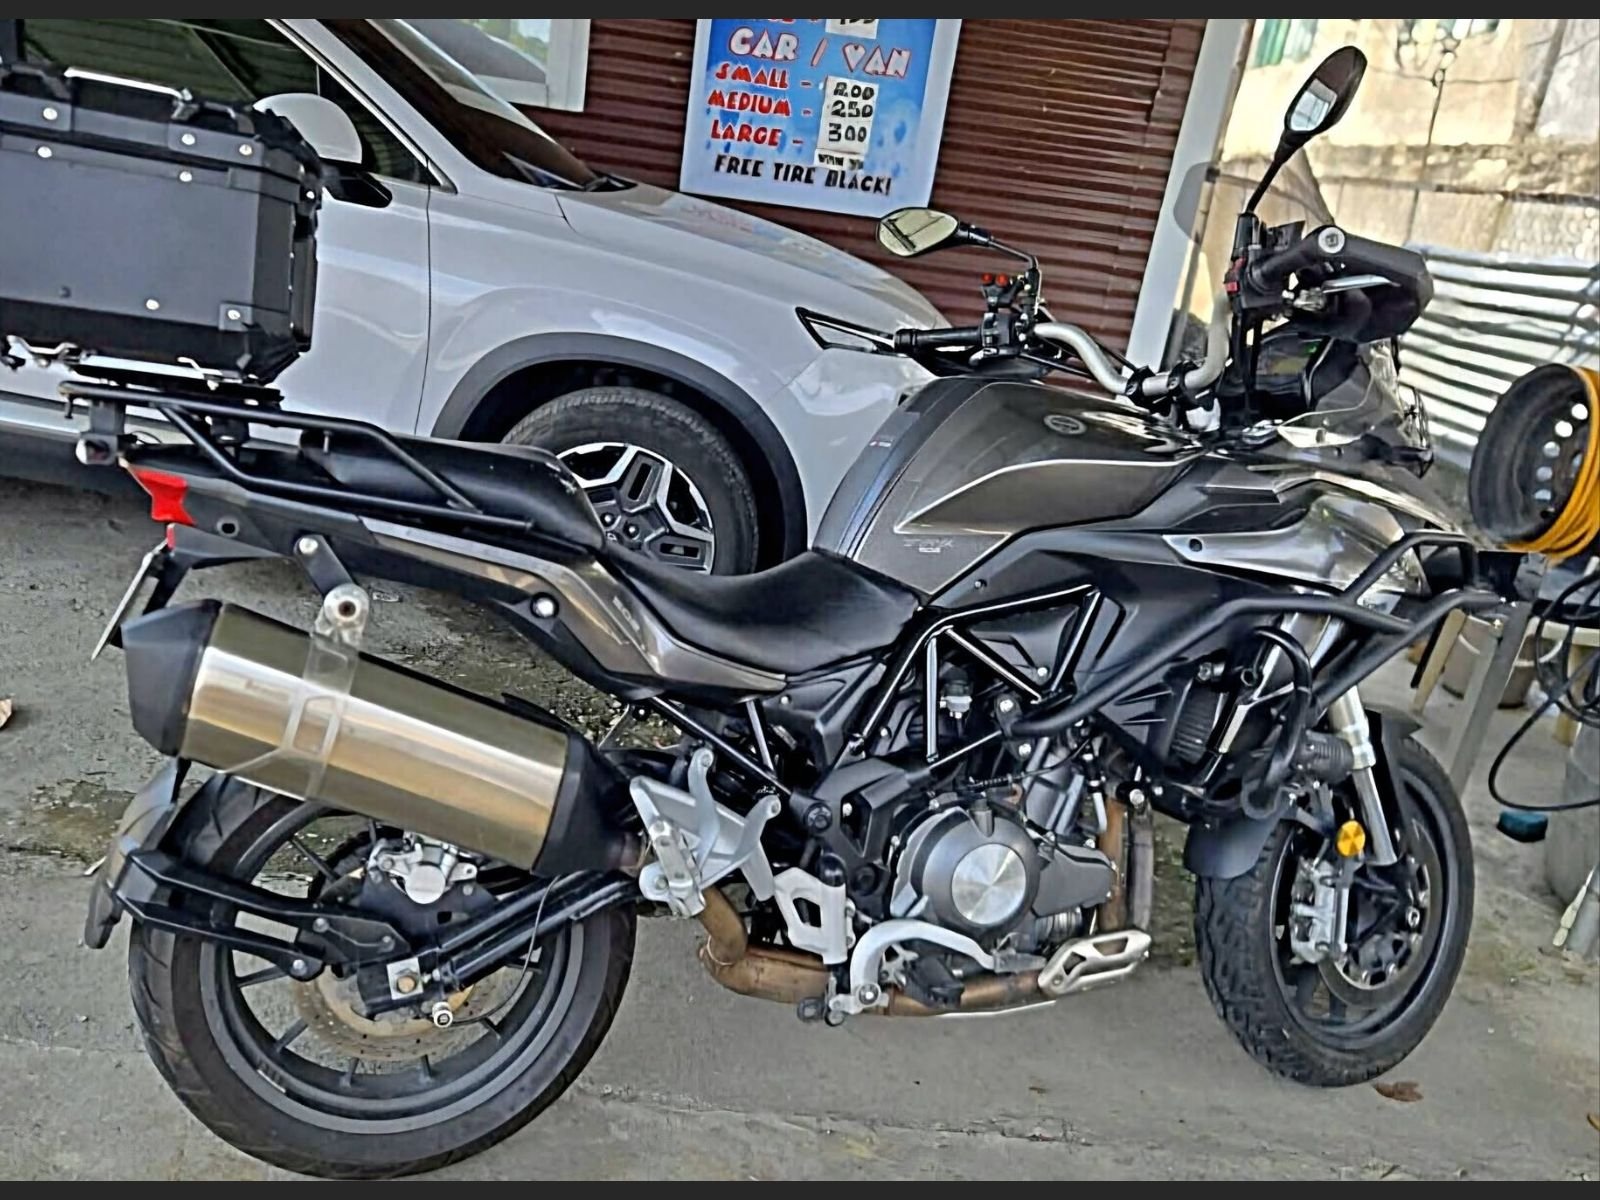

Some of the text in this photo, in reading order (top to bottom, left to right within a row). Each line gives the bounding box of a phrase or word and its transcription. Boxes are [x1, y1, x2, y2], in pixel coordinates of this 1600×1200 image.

[728, 26, 799, 62] CAR
[842, 42, 912, 78] VAN
[714, 62, 789, 90] SMALL
[707, 89, 791, 117] MEDIUM
[831, 99, 874, 118] 250
[710, 119, 784, 147] LARGE
[828, 122, 868, 143] 300
[714, 153, 765, 177] FREE
[773, 161, 816, 185] TIRE
[824, 169, 892, 197] BLACK!
